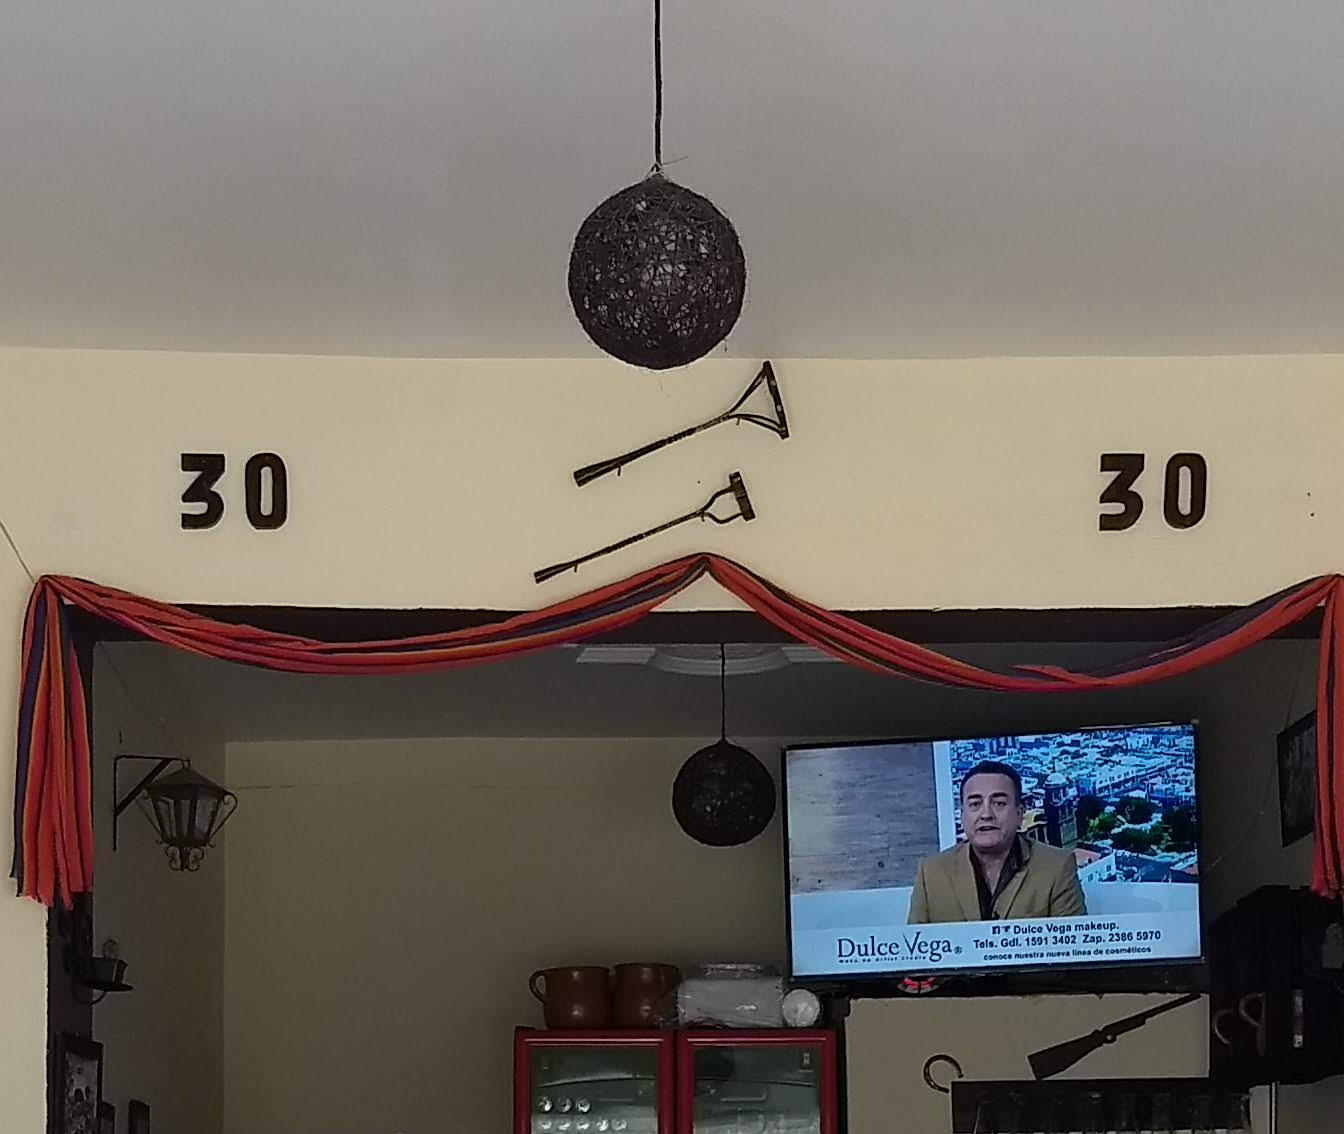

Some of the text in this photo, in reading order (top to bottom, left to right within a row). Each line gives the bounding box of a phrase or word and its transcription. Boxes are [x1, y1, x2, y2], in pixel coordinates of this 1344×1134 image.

[180, 452, 288, 531] 30
[1098, 452, 1208, 532] 30
[1013, 921, 1120, 935] Dulce Vega makeup.
[837, 935, 900, 957] Dulce
[973, 930, 1162, 949] Tels. Gdl. 1591 3402 Zap. 2386 5970
[983, 953, 1013, 961] conoce
[1014, 951, 1045, 960] nuestra
[1046, 950, 1071, 958] nueva
[1093, 947, 1104, 956] de
